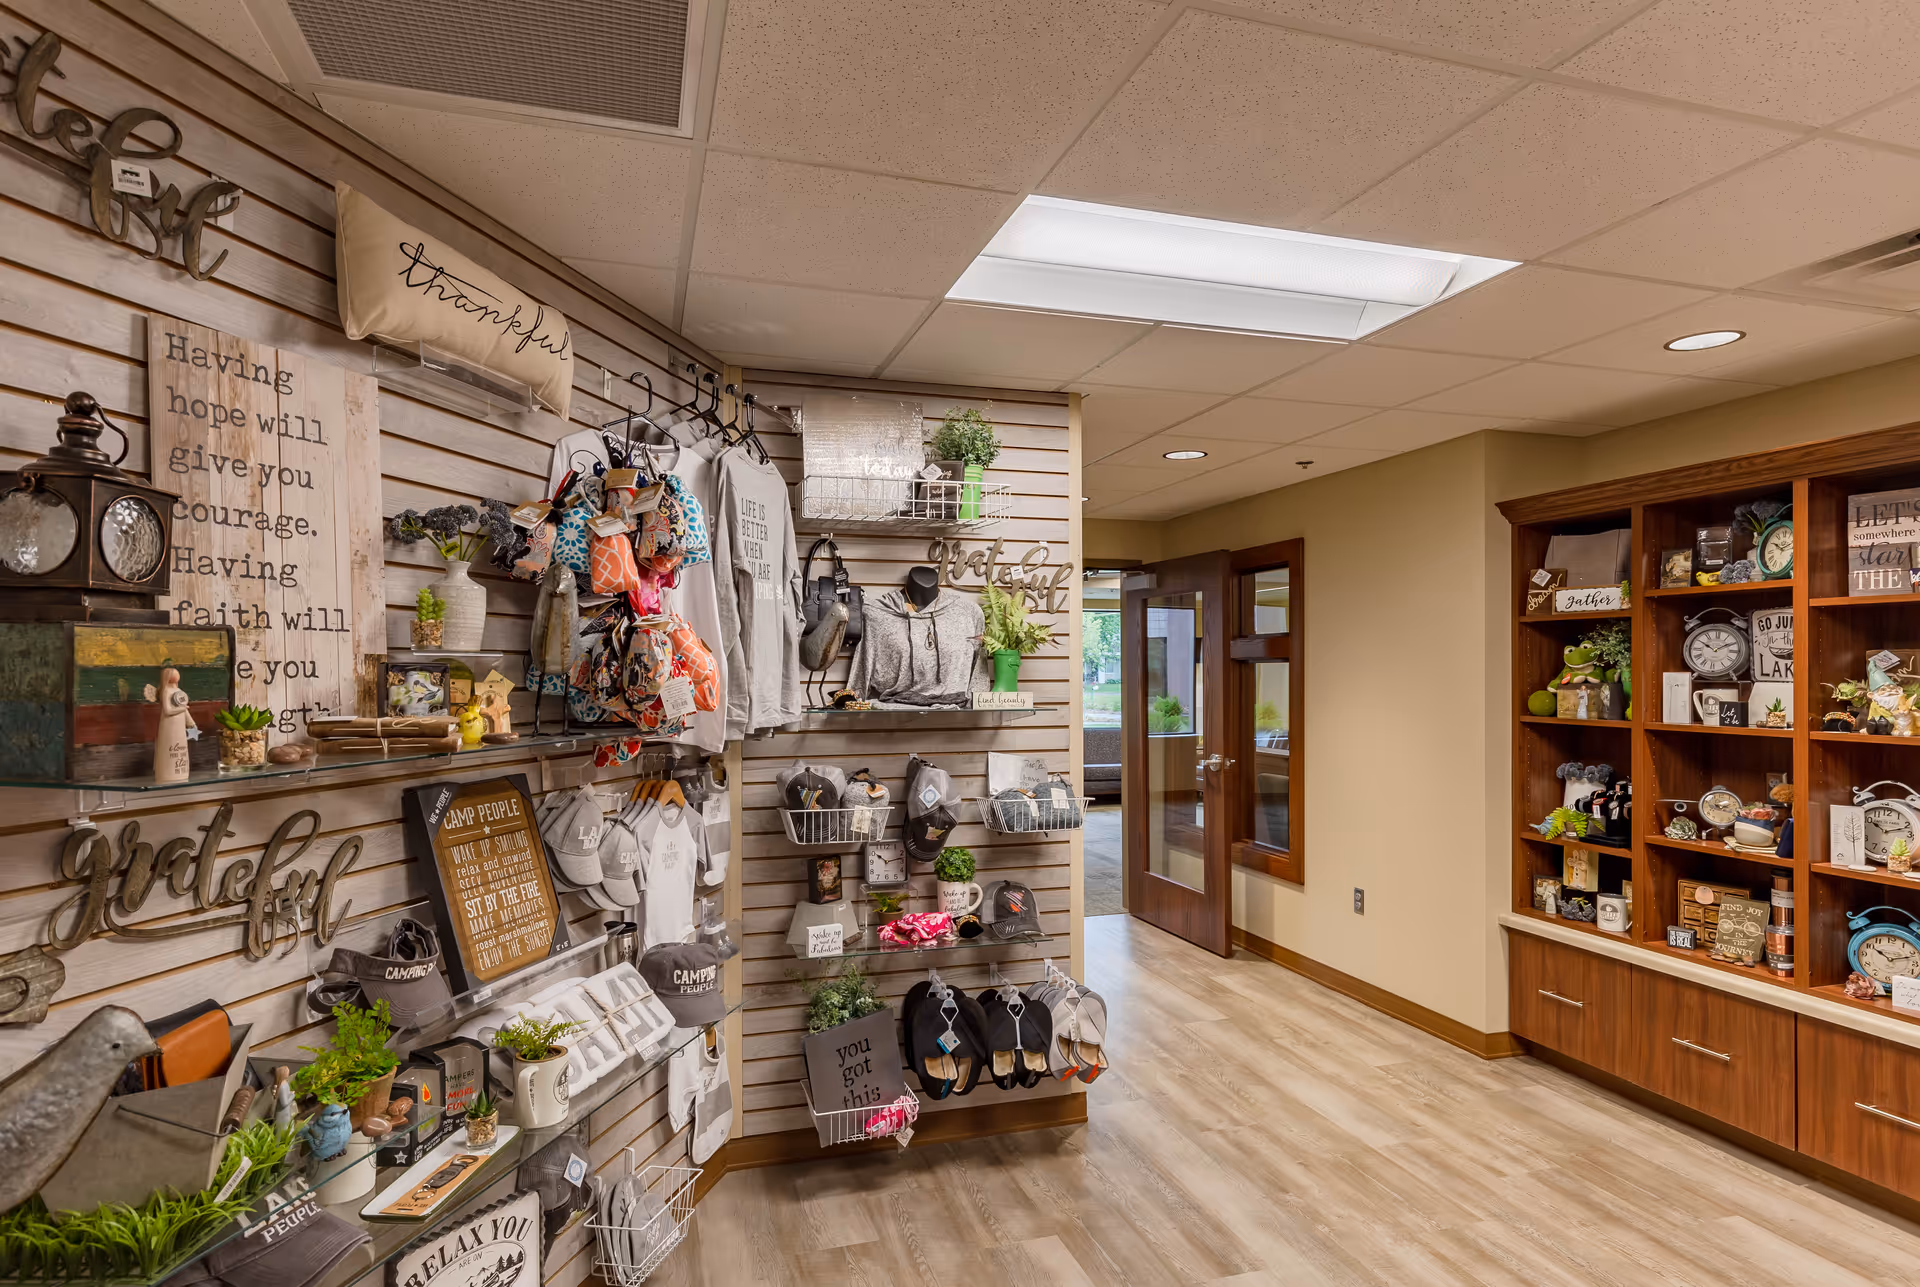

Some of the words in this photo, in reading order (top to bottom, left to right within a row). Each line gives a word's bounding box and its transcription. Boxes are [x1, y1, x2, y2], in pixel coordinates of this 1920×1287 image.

[398, 242, 568, 361] thankful
[165, 332, 294, 395] Having
[167, 386, 247, 429] hope
[256, 413, 328, 446] will
[169, 445, 248, 478] give
[258, 461, 315, 489] you
[172, 499, 318, 540] courage.
[741, 497, 757, 519] LIFE
[758, 503, 766, 521] IS
[741, 519, 769, 541] BETTER
[1853, 528, 1916, 541] somewhere
[171, 546, 299, 588] Having
[758, 561, 771, 580] ARE
[1853, 568, 1903, 591] THE
[755, 582, 774, 600] PING
[1528, 573, 1563, 611] dream
[1564, 590, 1616, 610] gather
[173, 600, 272, 630] faith
[280, 607, 351, 633] will
[1758, 617, 1772, 632] GO
[263, 659, 320, 686] you
[1721, 704, 1735, 717] Let
[1731, 716, 1740, 725] be
[443, 806, 475, 830] CAMP
[477, 799, 520, 823] PEOPLE
[1882, 809, 1893, 817] 12
[451, 842, 478, 865] WAKE
[480, 838, 491, 857] UP
[494, 830, 529, 854] SMILING
[456, 863, 480, 879] relax
[483, 859, 499, 871] and
[501, 849, 532, 866] unwind
[48, 800, 364, 959] grateful
[465, 897, 483, 919] SIT
[484, 892, 499, 914] BY
[499, 885, 518, 905] THE
[521, 880, 541, 902] FIRE
[1721, 903, 1743, 912] FIND
[1746, 906, 1763, 917] JOY
[475, 937, 497, 952] roast
[498, 918, 549, 943] marshmallows
[1670, 936, 1677, 947] IS
[1677, 937, 1692, 949] REAL
[1732, 940, 1748, 948] THE
[477, 946, 504, 971] ENJOY
[505, 940, 523, 959] THE
[524, 927, 553, 953] SUNSET
[1715, 942, 1755, 957] JOURNEY
[673, 964, 717, 985] CAMPING
[680, 980, 714, 993] PEOPLE
[836, 1038, 872, 1068] you
[444, 1069, 475, 1083] AMPERS
[842, 1056, 872, 1088] got
[842, 1084, 881, 1109] this
[260, 1201, 322, 1243] PEOPLE
[403, 1223, 484, 1287] RELAX
[490, 1215, 534, 1242] YOU
[458, 1257, 472, 1270] ARE
[472, 1251, 483, 1262] ON
